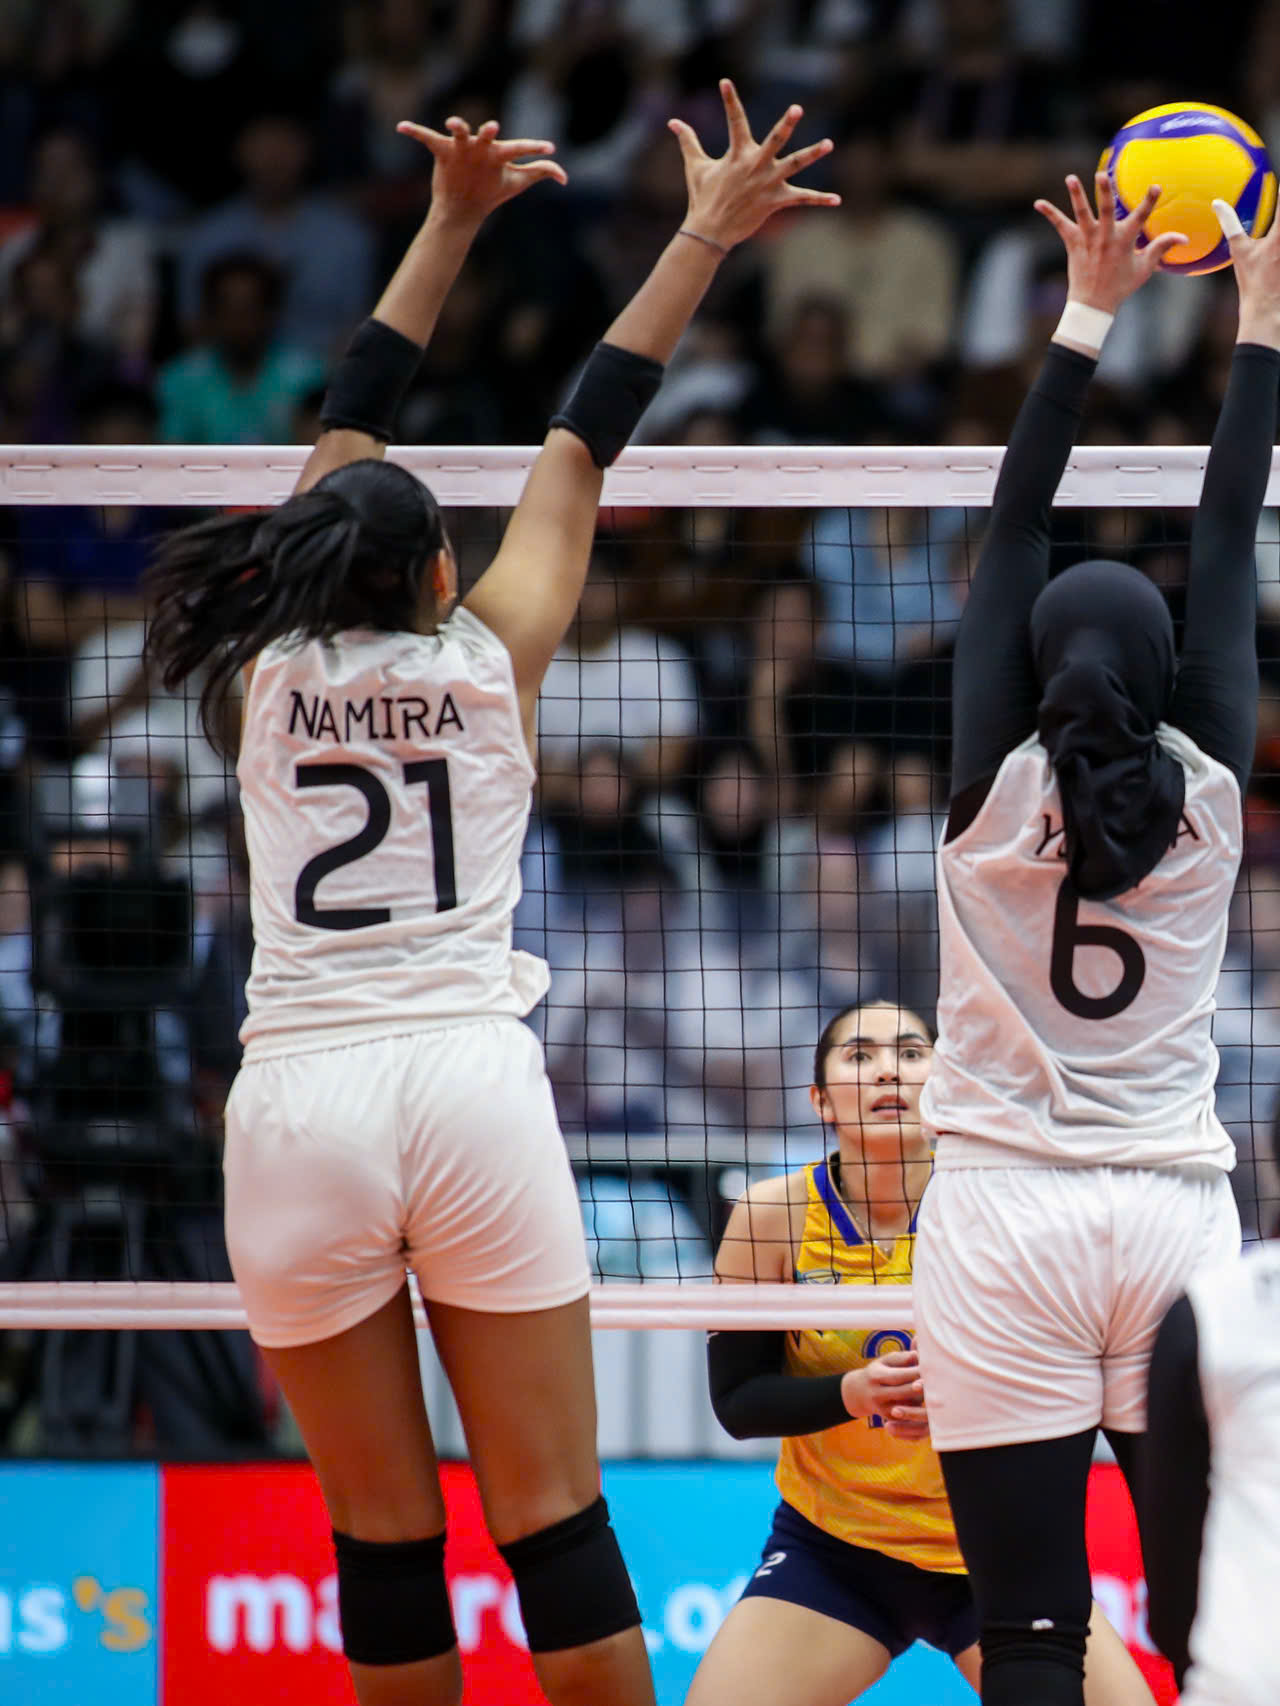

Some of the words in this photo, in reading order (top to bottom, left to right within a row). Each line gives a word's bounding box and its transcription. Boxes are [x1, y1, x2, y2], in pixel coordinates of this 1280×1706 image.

[286, 690, 465, 744] NAMIRA
[295, 757, 457, 930] 21
[1050, 872, 1146, 1020] 6
